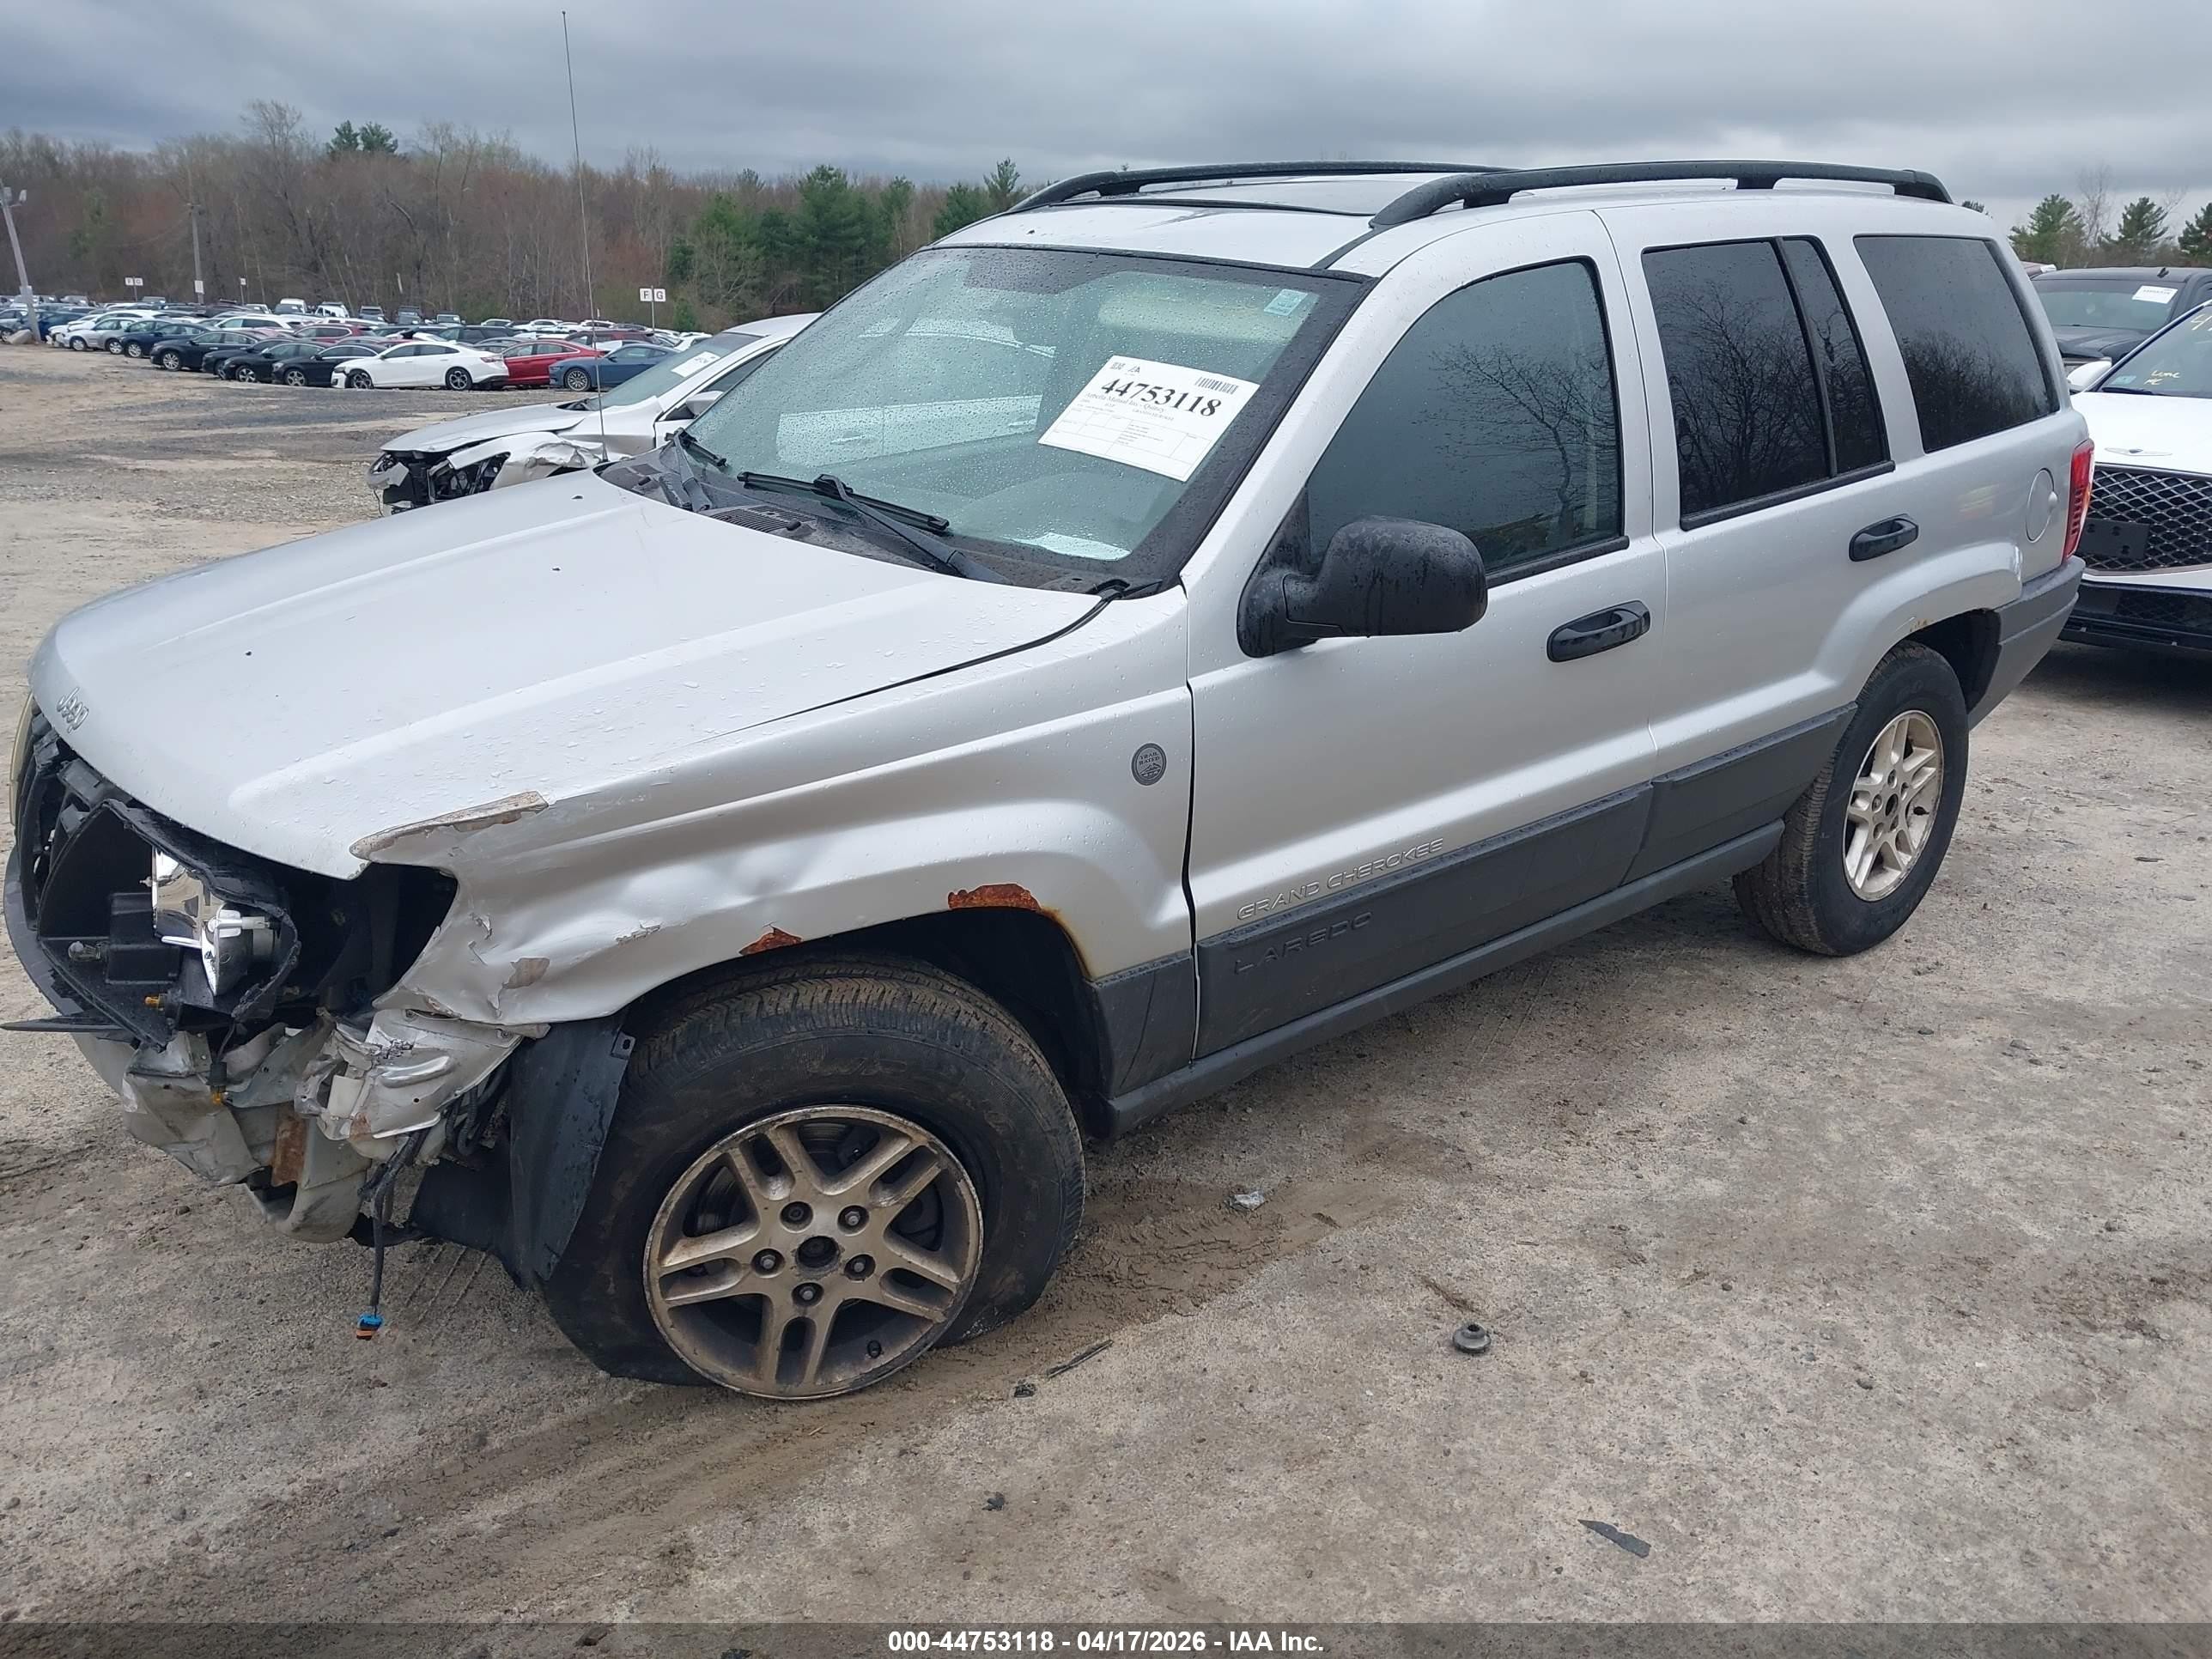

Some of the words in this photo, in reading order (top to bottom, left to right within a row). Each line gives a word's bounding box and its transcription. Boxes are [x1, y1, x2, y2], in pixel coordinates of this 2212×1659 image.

[643, 290, 650, 300] F
[656, 290, 664, 300] G
[1102, 378, 1222, 416] 44753118
[57, 687, 89, 734] Jeep
[1237, 881, 1320, 921] GRAND
[1327, 837, 1443, 890] CHEROKEE
[1234, 911, 1372, 975] LAREDO
